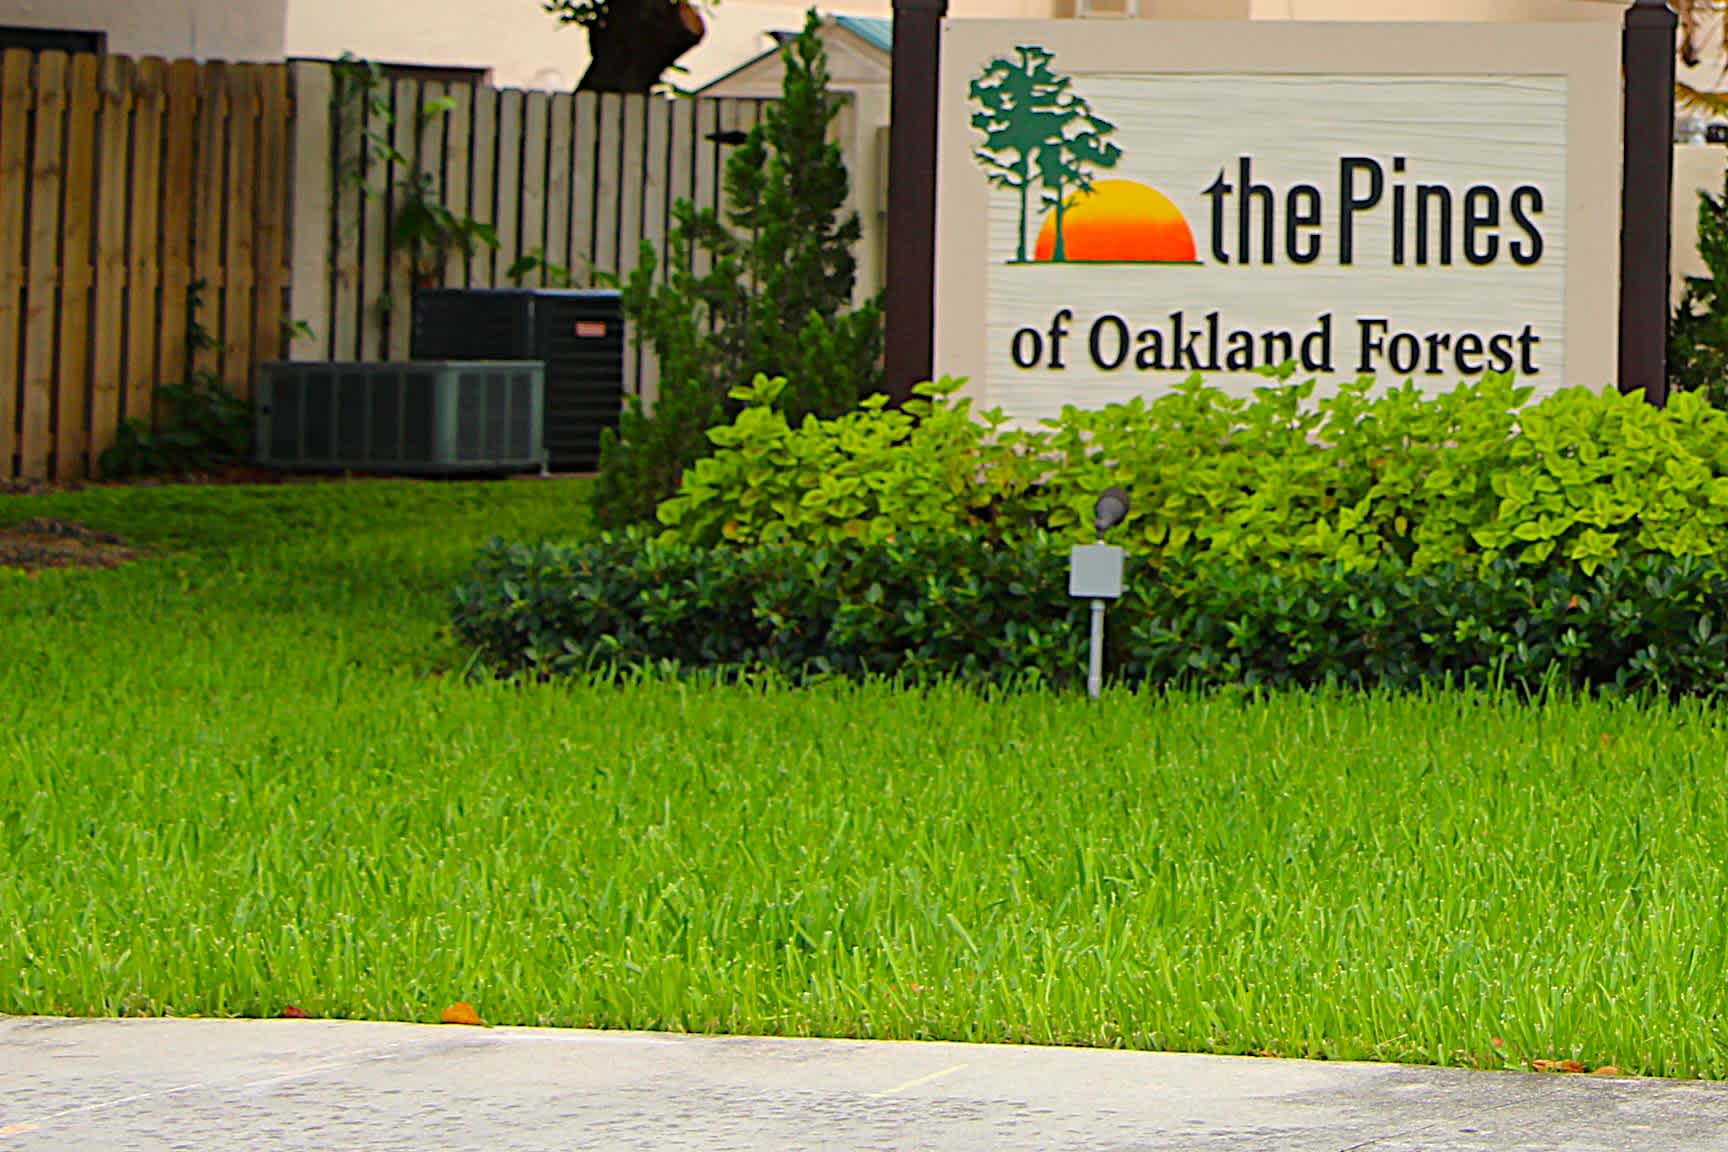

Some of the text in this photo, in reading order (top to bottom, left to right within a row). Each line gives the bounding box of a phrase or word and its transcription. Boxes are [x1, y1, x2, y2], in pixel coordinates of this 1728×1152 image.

[1010, 308, 1541, 376] of Oakland Forest
